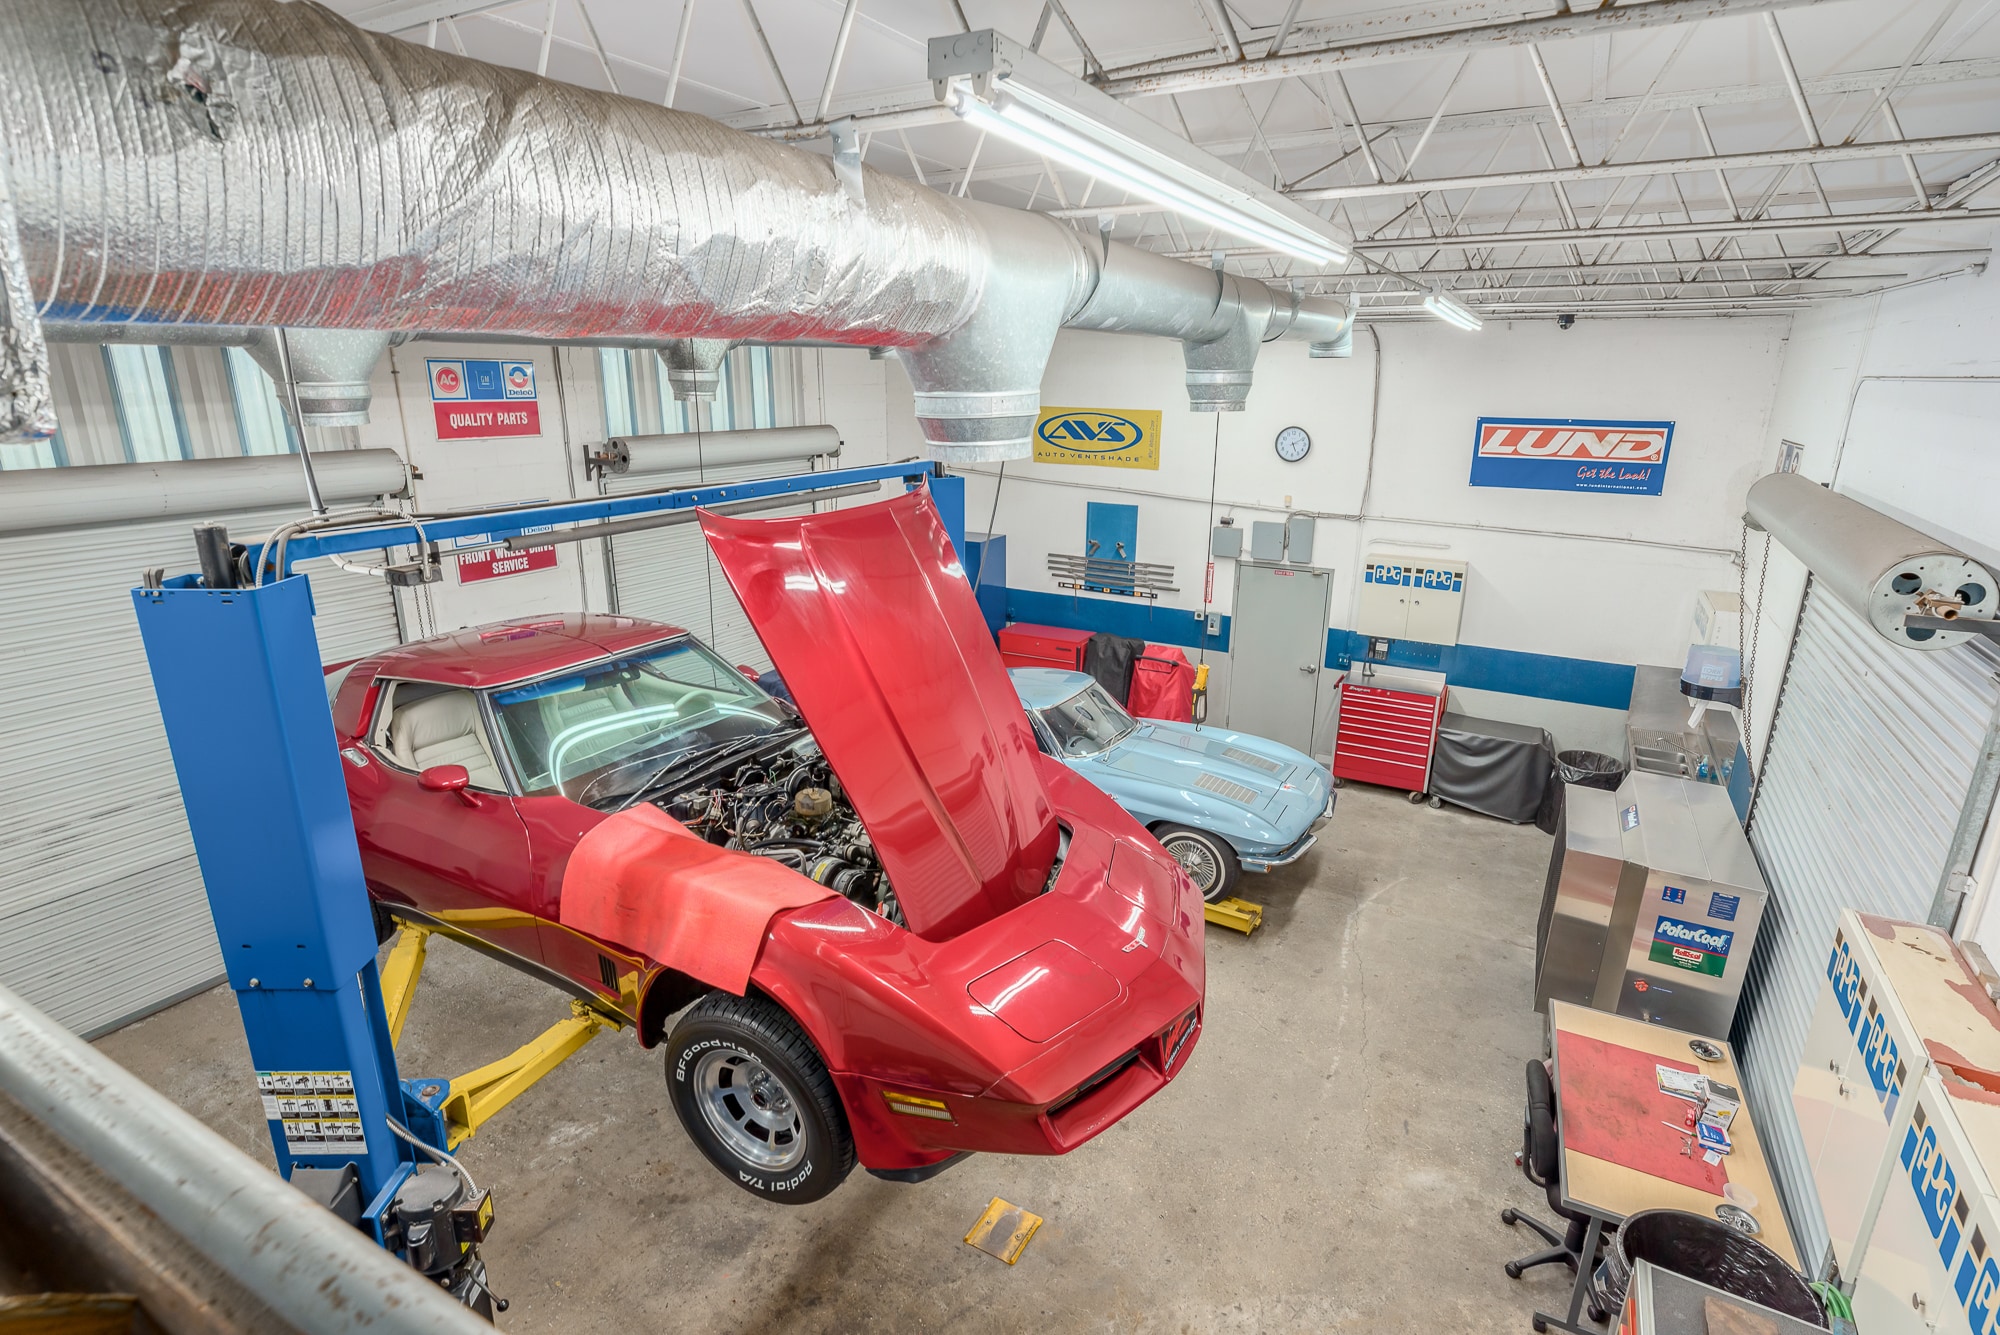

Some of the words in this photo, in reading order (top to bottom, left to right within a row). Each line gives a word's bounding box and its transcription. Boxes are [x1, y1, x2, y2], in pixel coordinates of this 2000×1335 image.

[440, 373, 456, 386] AC
[480, 375, 490, 384] GM
[449, 413, 493, 429] QUALITY
[497, 412, 528, 425] PARTS
[1047, 419, 1126, 442] AVS
[1481, 429, 1663, 458] LUND
[1070, 453, 1140, 463] VENTSHADE
[1577, 466, 1598, 480] Get
[1599, 467, 1616, 479] the
[1618, 467, 1652, 481] Look!
[527, 526, 550, 534] Delco
[459, 549, 491, 566] FRONT
[492, 557, 529, 574] SERVICE
[1657, 920, 1728, 948] PolarCool
[676, 1039, 762, 1082] BFGoodrich
[739, 1170, 765, 1190] T/A
[770, 1160, 813, 1192] Radial
[1916, 1136, 1953, 1221] PPG
